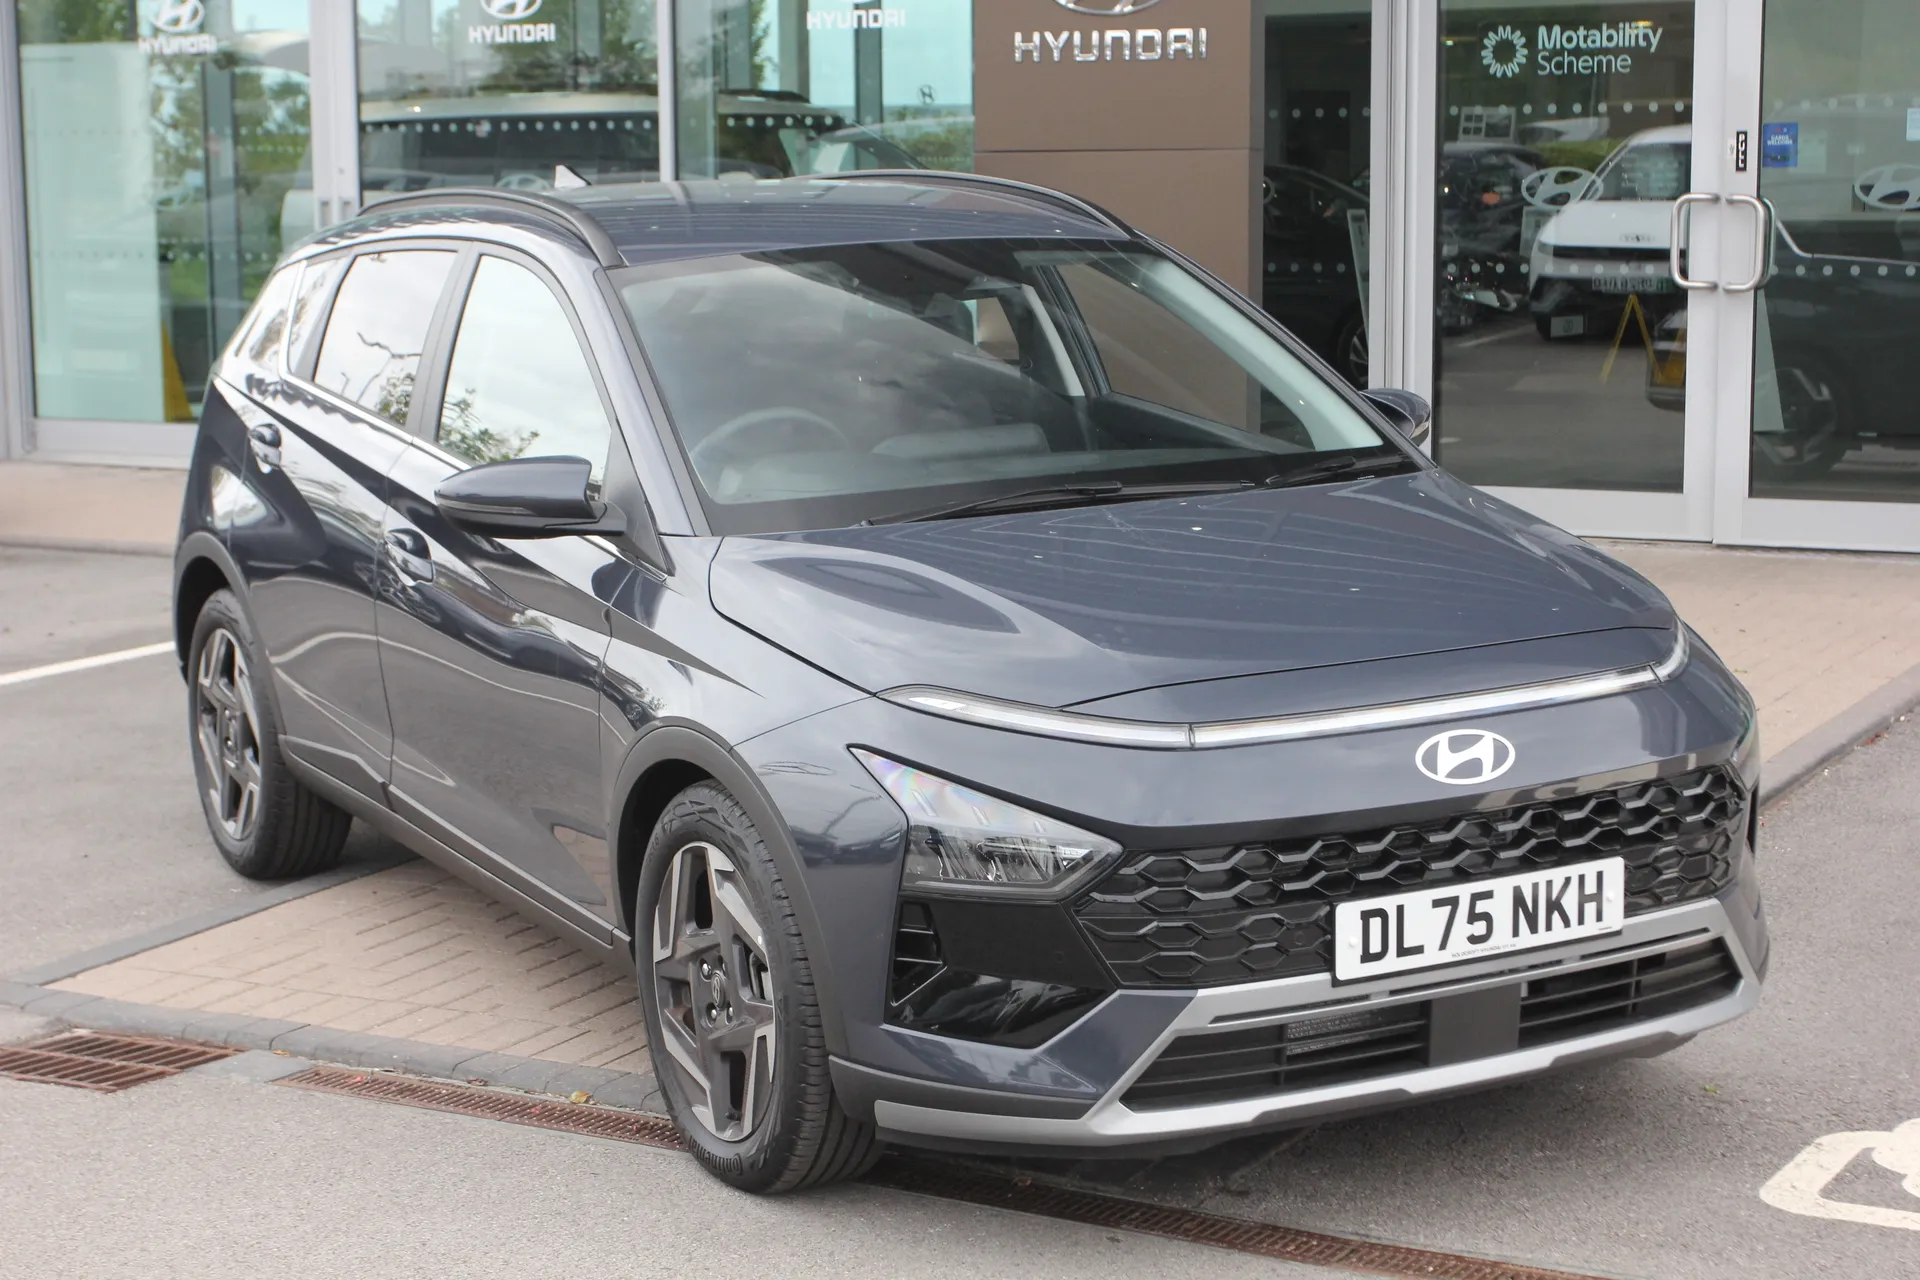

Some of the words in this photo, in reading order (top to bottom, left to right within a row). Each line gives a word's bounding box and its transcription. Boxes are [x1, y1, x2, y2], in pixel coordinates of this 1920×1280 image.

[468, 22, 556, 43] HYUNDAI
[806, 8, 906, 30] HYUNDAI
[1014, 27, 1208, 62] HYUNDAI
[1537, 21, 1663, 52] Motability
[1537, 51, 1632, 75] Scheme
[1360, 890, 1494, 964] DL75
[1511, 870, 1604, 938] NKH
